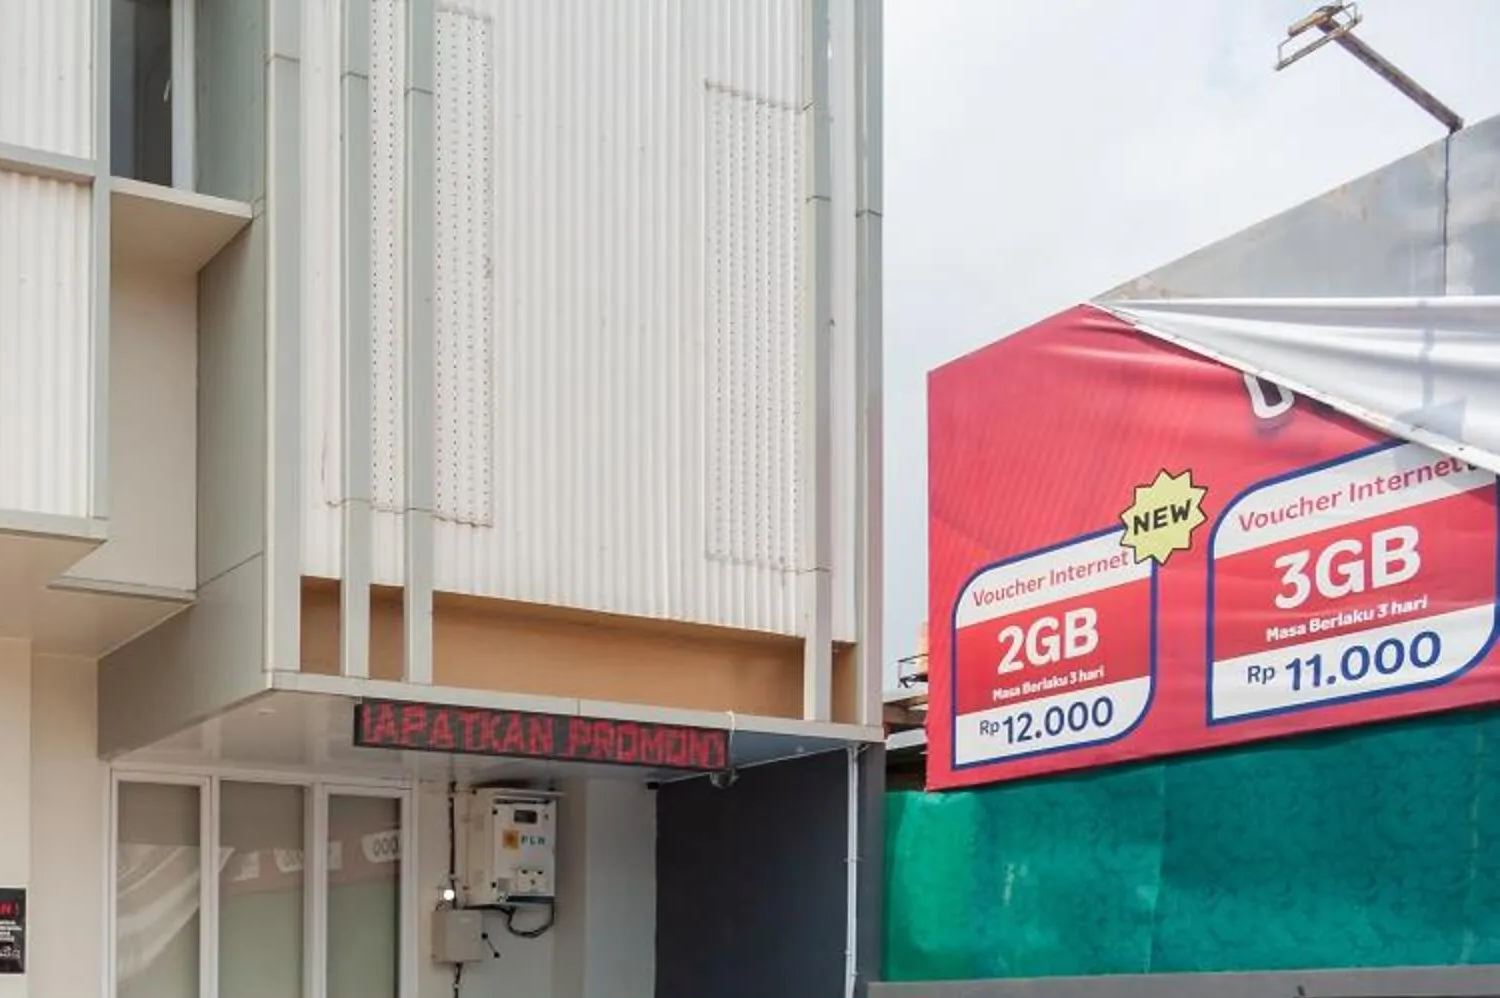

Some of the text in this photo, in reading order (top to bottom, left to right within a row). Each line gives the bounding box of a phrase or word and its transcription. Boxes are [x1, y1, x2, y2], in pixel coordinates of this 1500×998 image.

[1133, 499, 1191, 536] NEW
[1239, 457, 1462, 531] Voucher Internet
[973, 551, 1129, 607] Voucher Internet
[1274, 525, 1421, 609] 3GB
[997, 607, 1099, 675] 2GB
[1266, 595, 1428, 642] Masa Berlaku 3 hari
[993, 665, 1105, 701] Masa Berlaku 3 hari
[1247, 631, 1442, 692] Rp 11.000
[979, 696, 1114, 744] Rp 12.000
